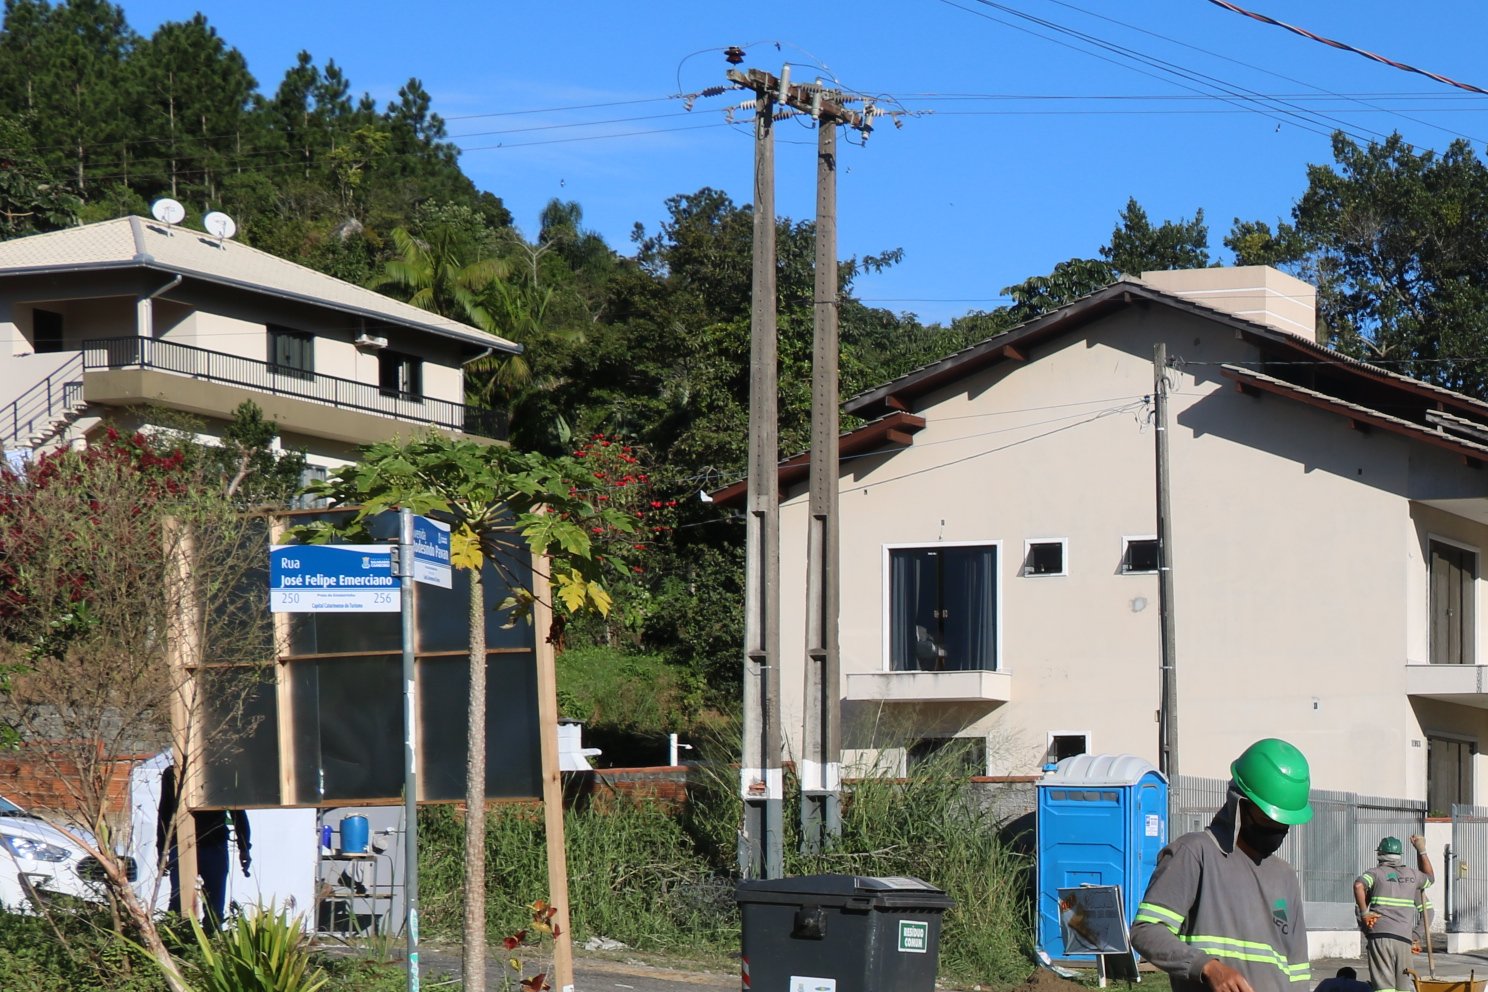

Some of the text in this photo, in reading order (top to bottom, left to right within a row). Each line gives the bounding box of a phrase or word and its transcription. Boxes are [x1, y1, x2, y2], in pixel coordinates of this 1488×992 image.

[281, 557, 300, 569] Rua
[281, 574, 393, 588] José Felipe Emerciano
[282, 593, 392, 604] 250 256
[905, 938, 923, 948] COMUM
